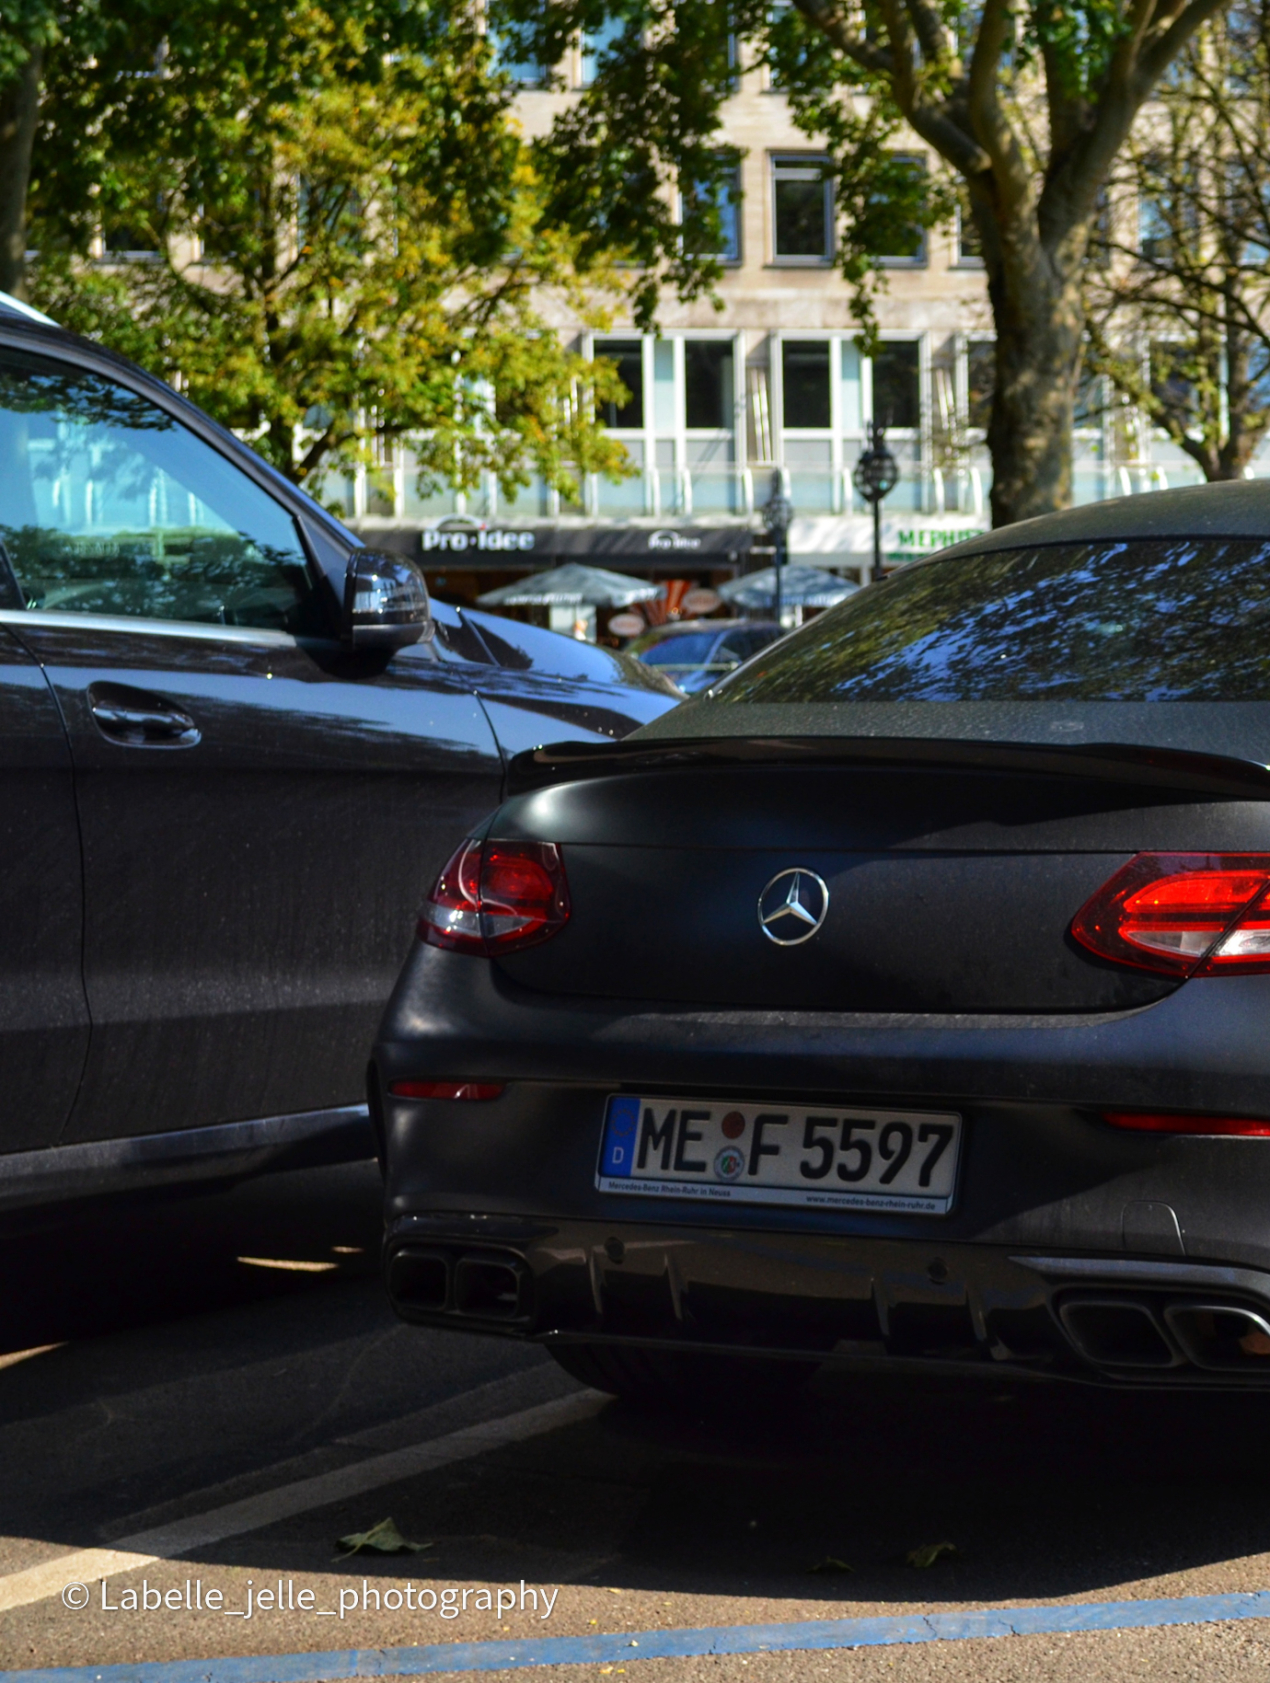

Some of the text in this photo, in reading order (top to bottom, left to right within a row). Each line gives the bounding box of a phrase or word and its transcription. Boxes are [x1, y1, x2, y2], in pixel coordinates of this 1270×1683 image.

[636, 1107, 954, 1187] ME F 5597
[612, 1147, 624, 1164] D
[608, 1181, 660, 1193] Mercedes-Benz
[661, 1185, 698, 1195] Rhein-Ruhr
[700, 1187, 707, 1195] in
[806, 1195, 936, 1210] www.mercedes-benz-rhein-ruhr.de
